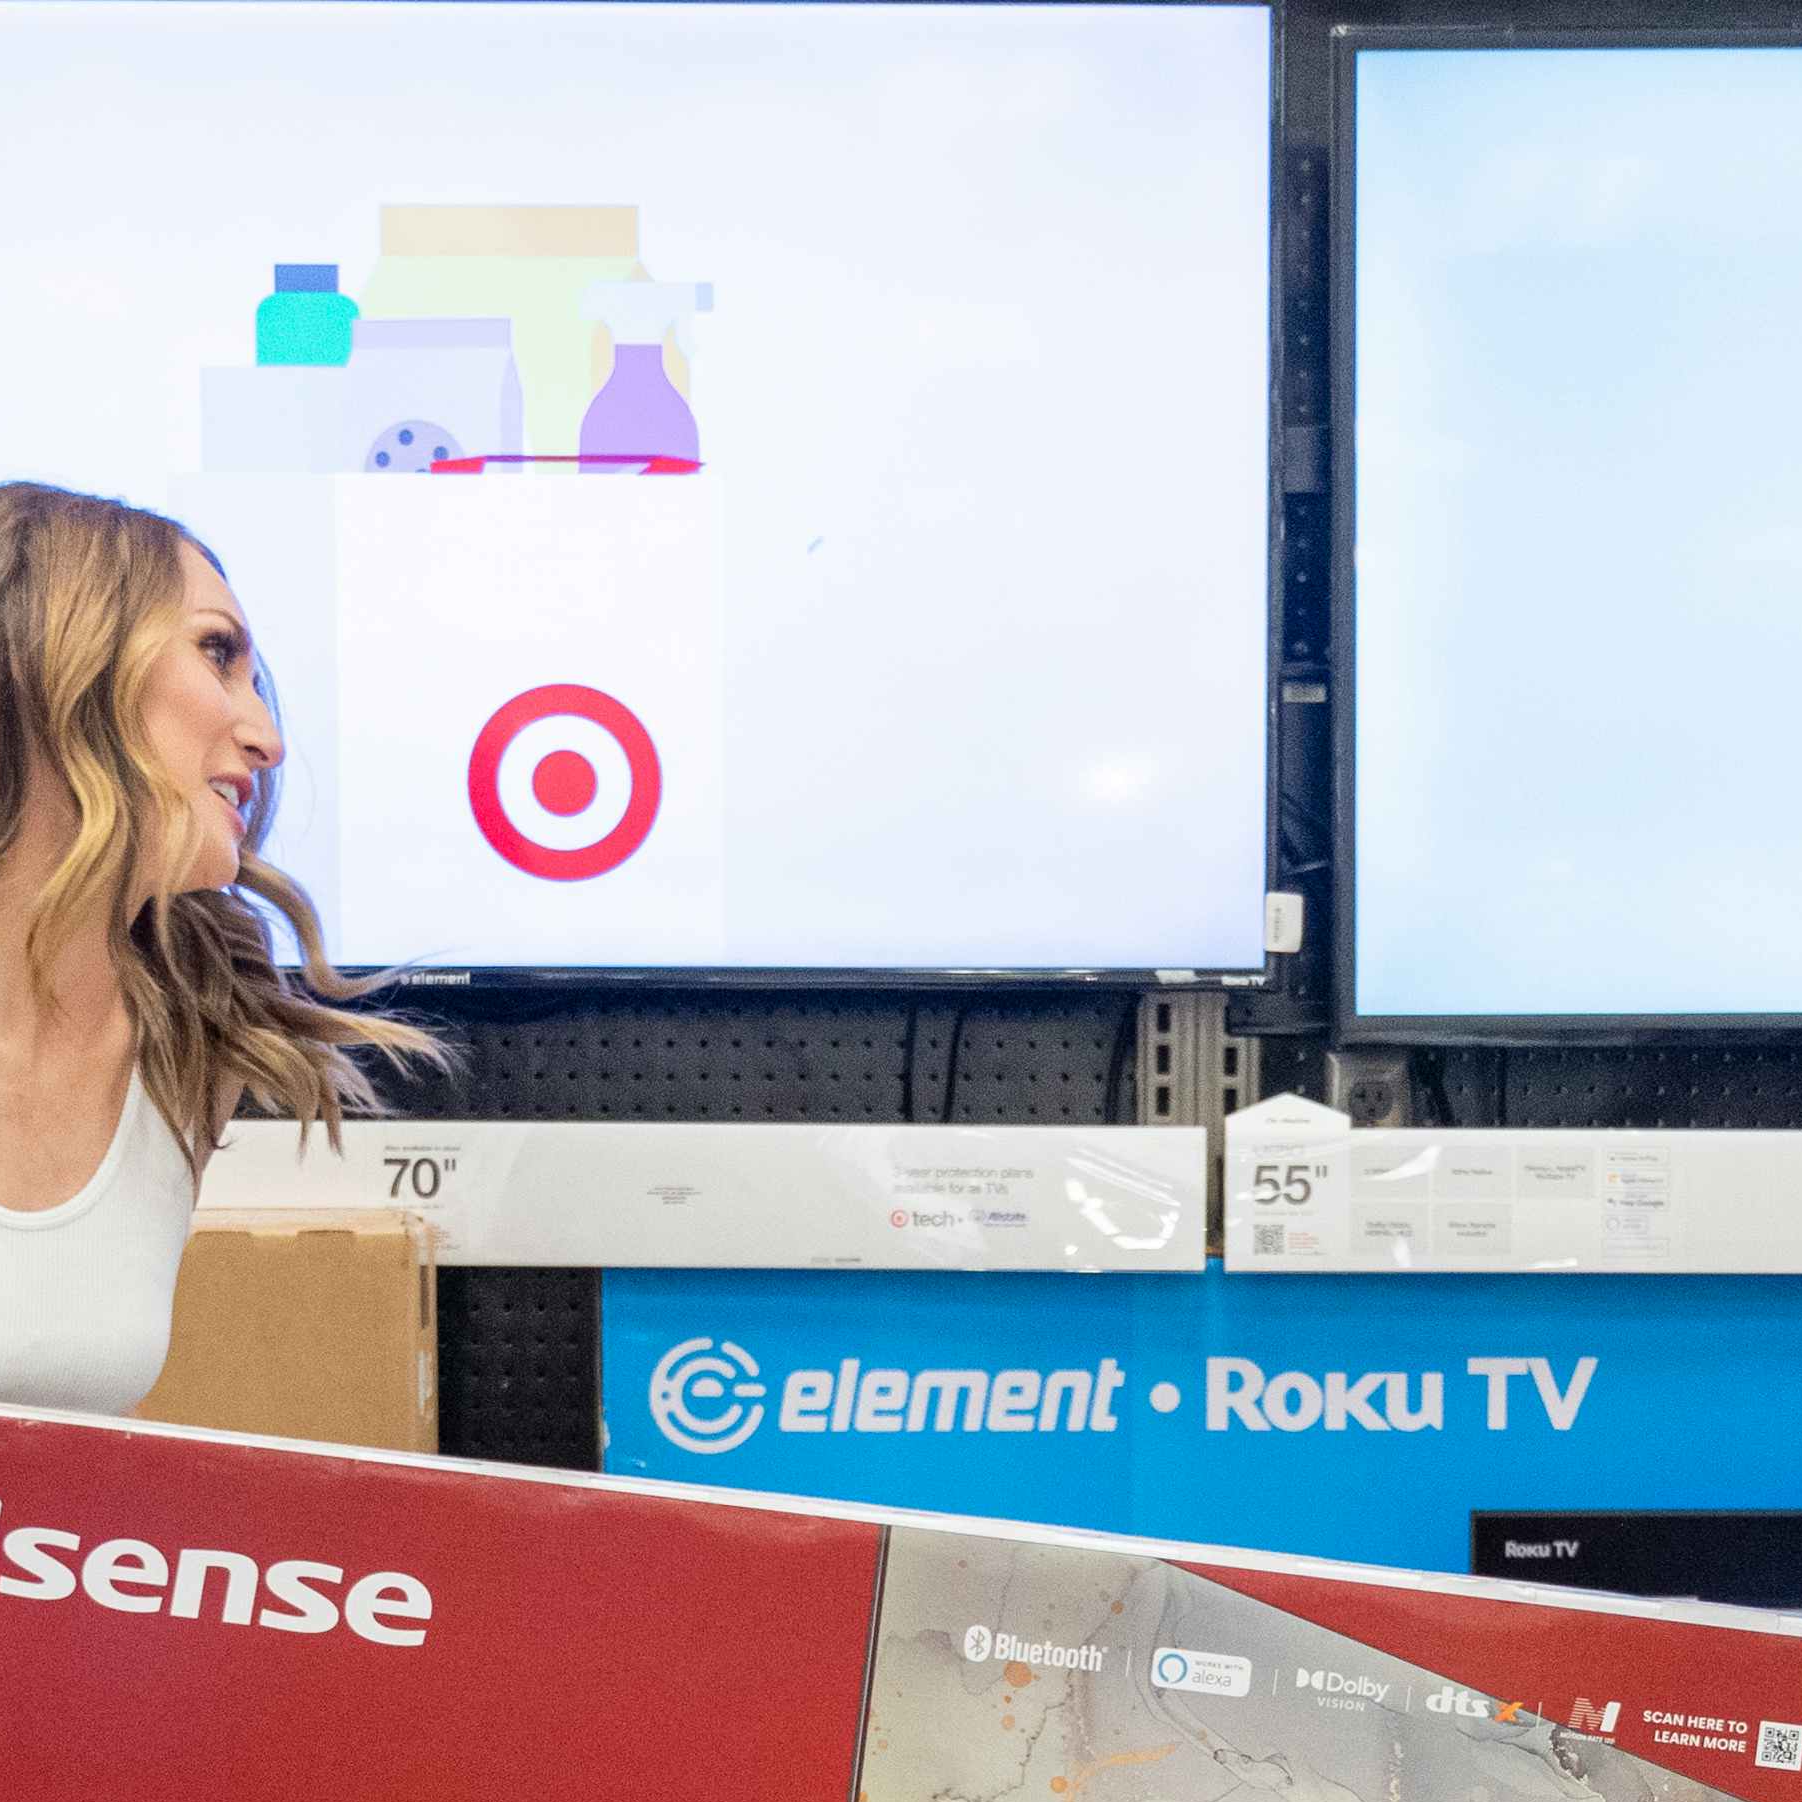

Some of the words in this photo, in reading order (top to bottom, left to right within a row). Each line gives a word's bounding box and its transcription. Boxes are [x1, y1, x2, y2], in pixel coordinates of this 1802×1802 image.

[383, 1158, 457, 1199] 70"
[1253, 1164, 1328, 1206] 55"
[779, 1358, 1125, 1434] element
[1466, 1356, 1599, 1432] TV
[1553, 1540, 1580, 1560] TV
[1192, 1667, 1233, 1690] alexa
[1327, 1671, 1392, 1702] Dolby
[1316, 1696, 1367, 1713] VISION
[1642, 1710, 1685, 1727] SCAN
[1687, 1715, 1724, 1732] HERE
[1727, 1720, 1748, 1734] TO
[1653, 1730, 1701, 1747] LEARN
[1702, 1735, 1747, 1753] MORE
